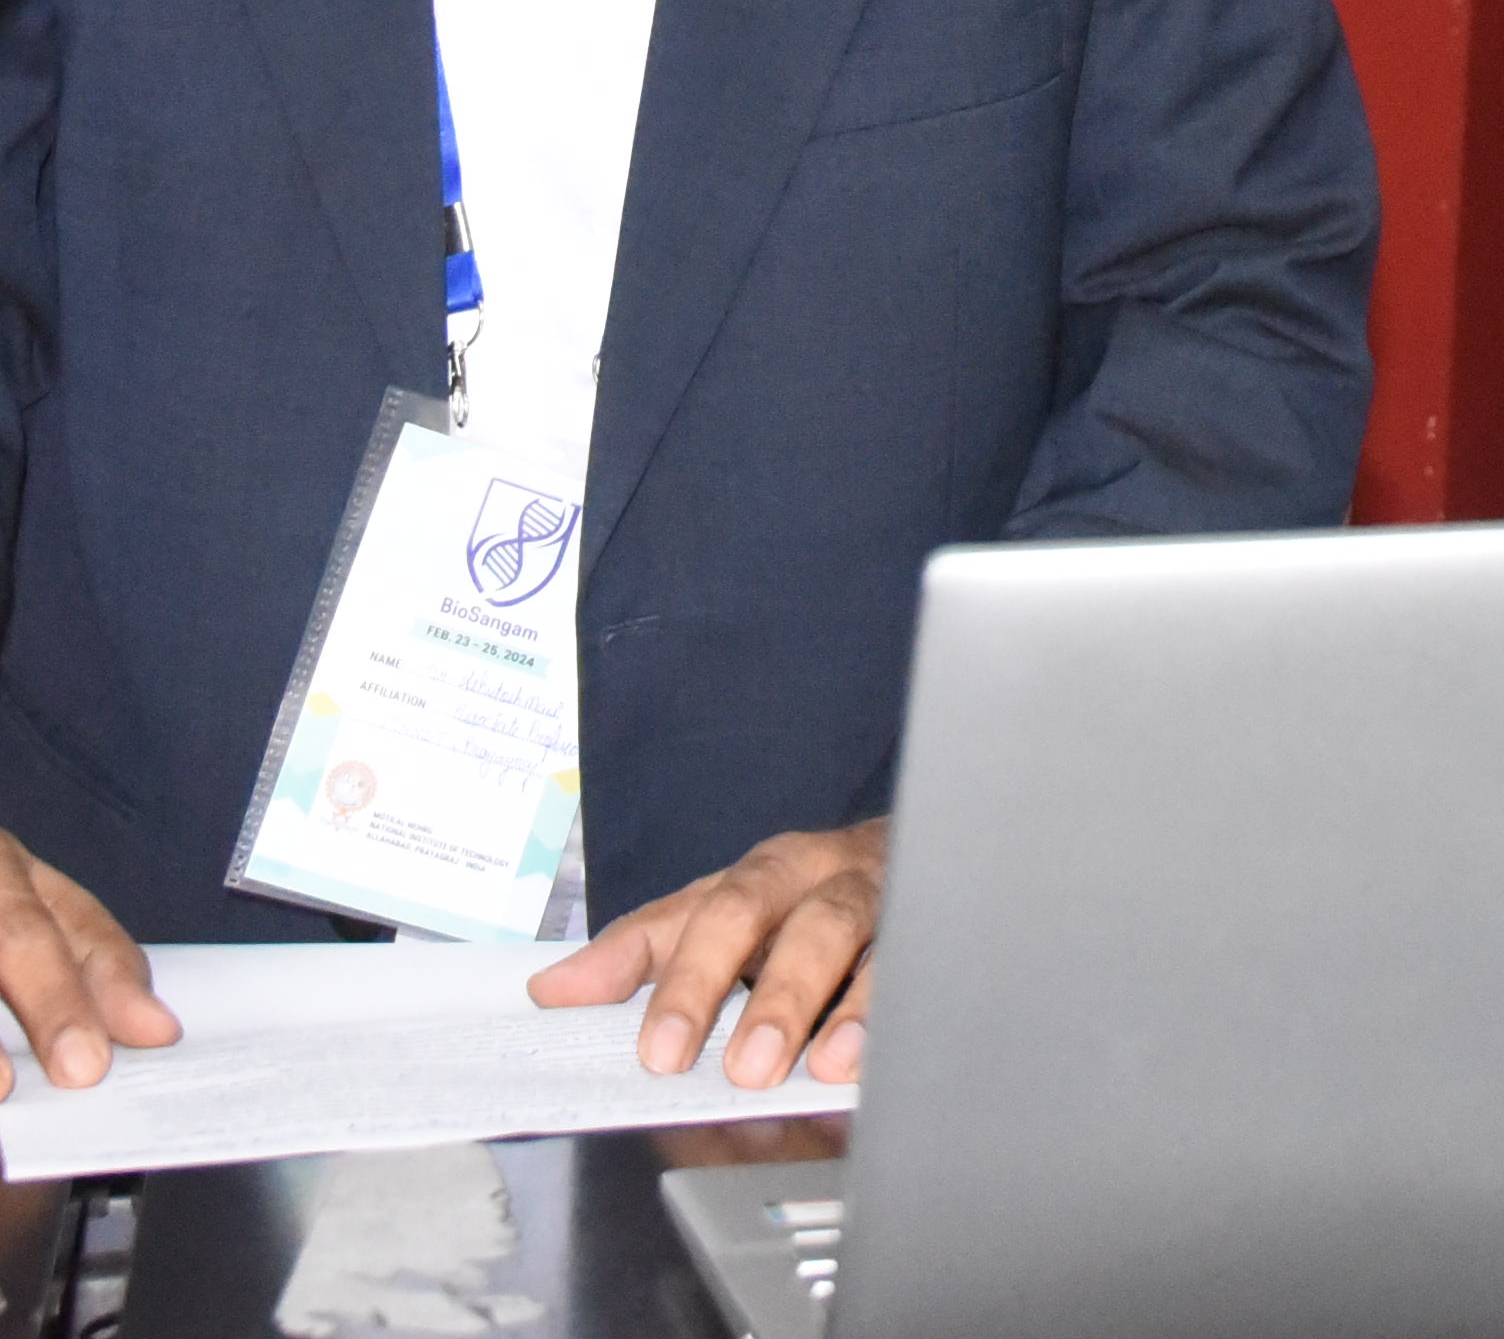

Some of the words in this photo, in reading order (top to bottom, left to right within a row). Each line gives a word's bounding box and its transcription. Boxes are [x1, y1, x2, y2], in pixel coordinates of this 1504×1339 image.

[439, 596, 540, 643] BioSangam
[454, 632, 472, 649] 23
[502, 648, 536, 669] 2024
[359, 679, 427, 710] AFFILIATION
